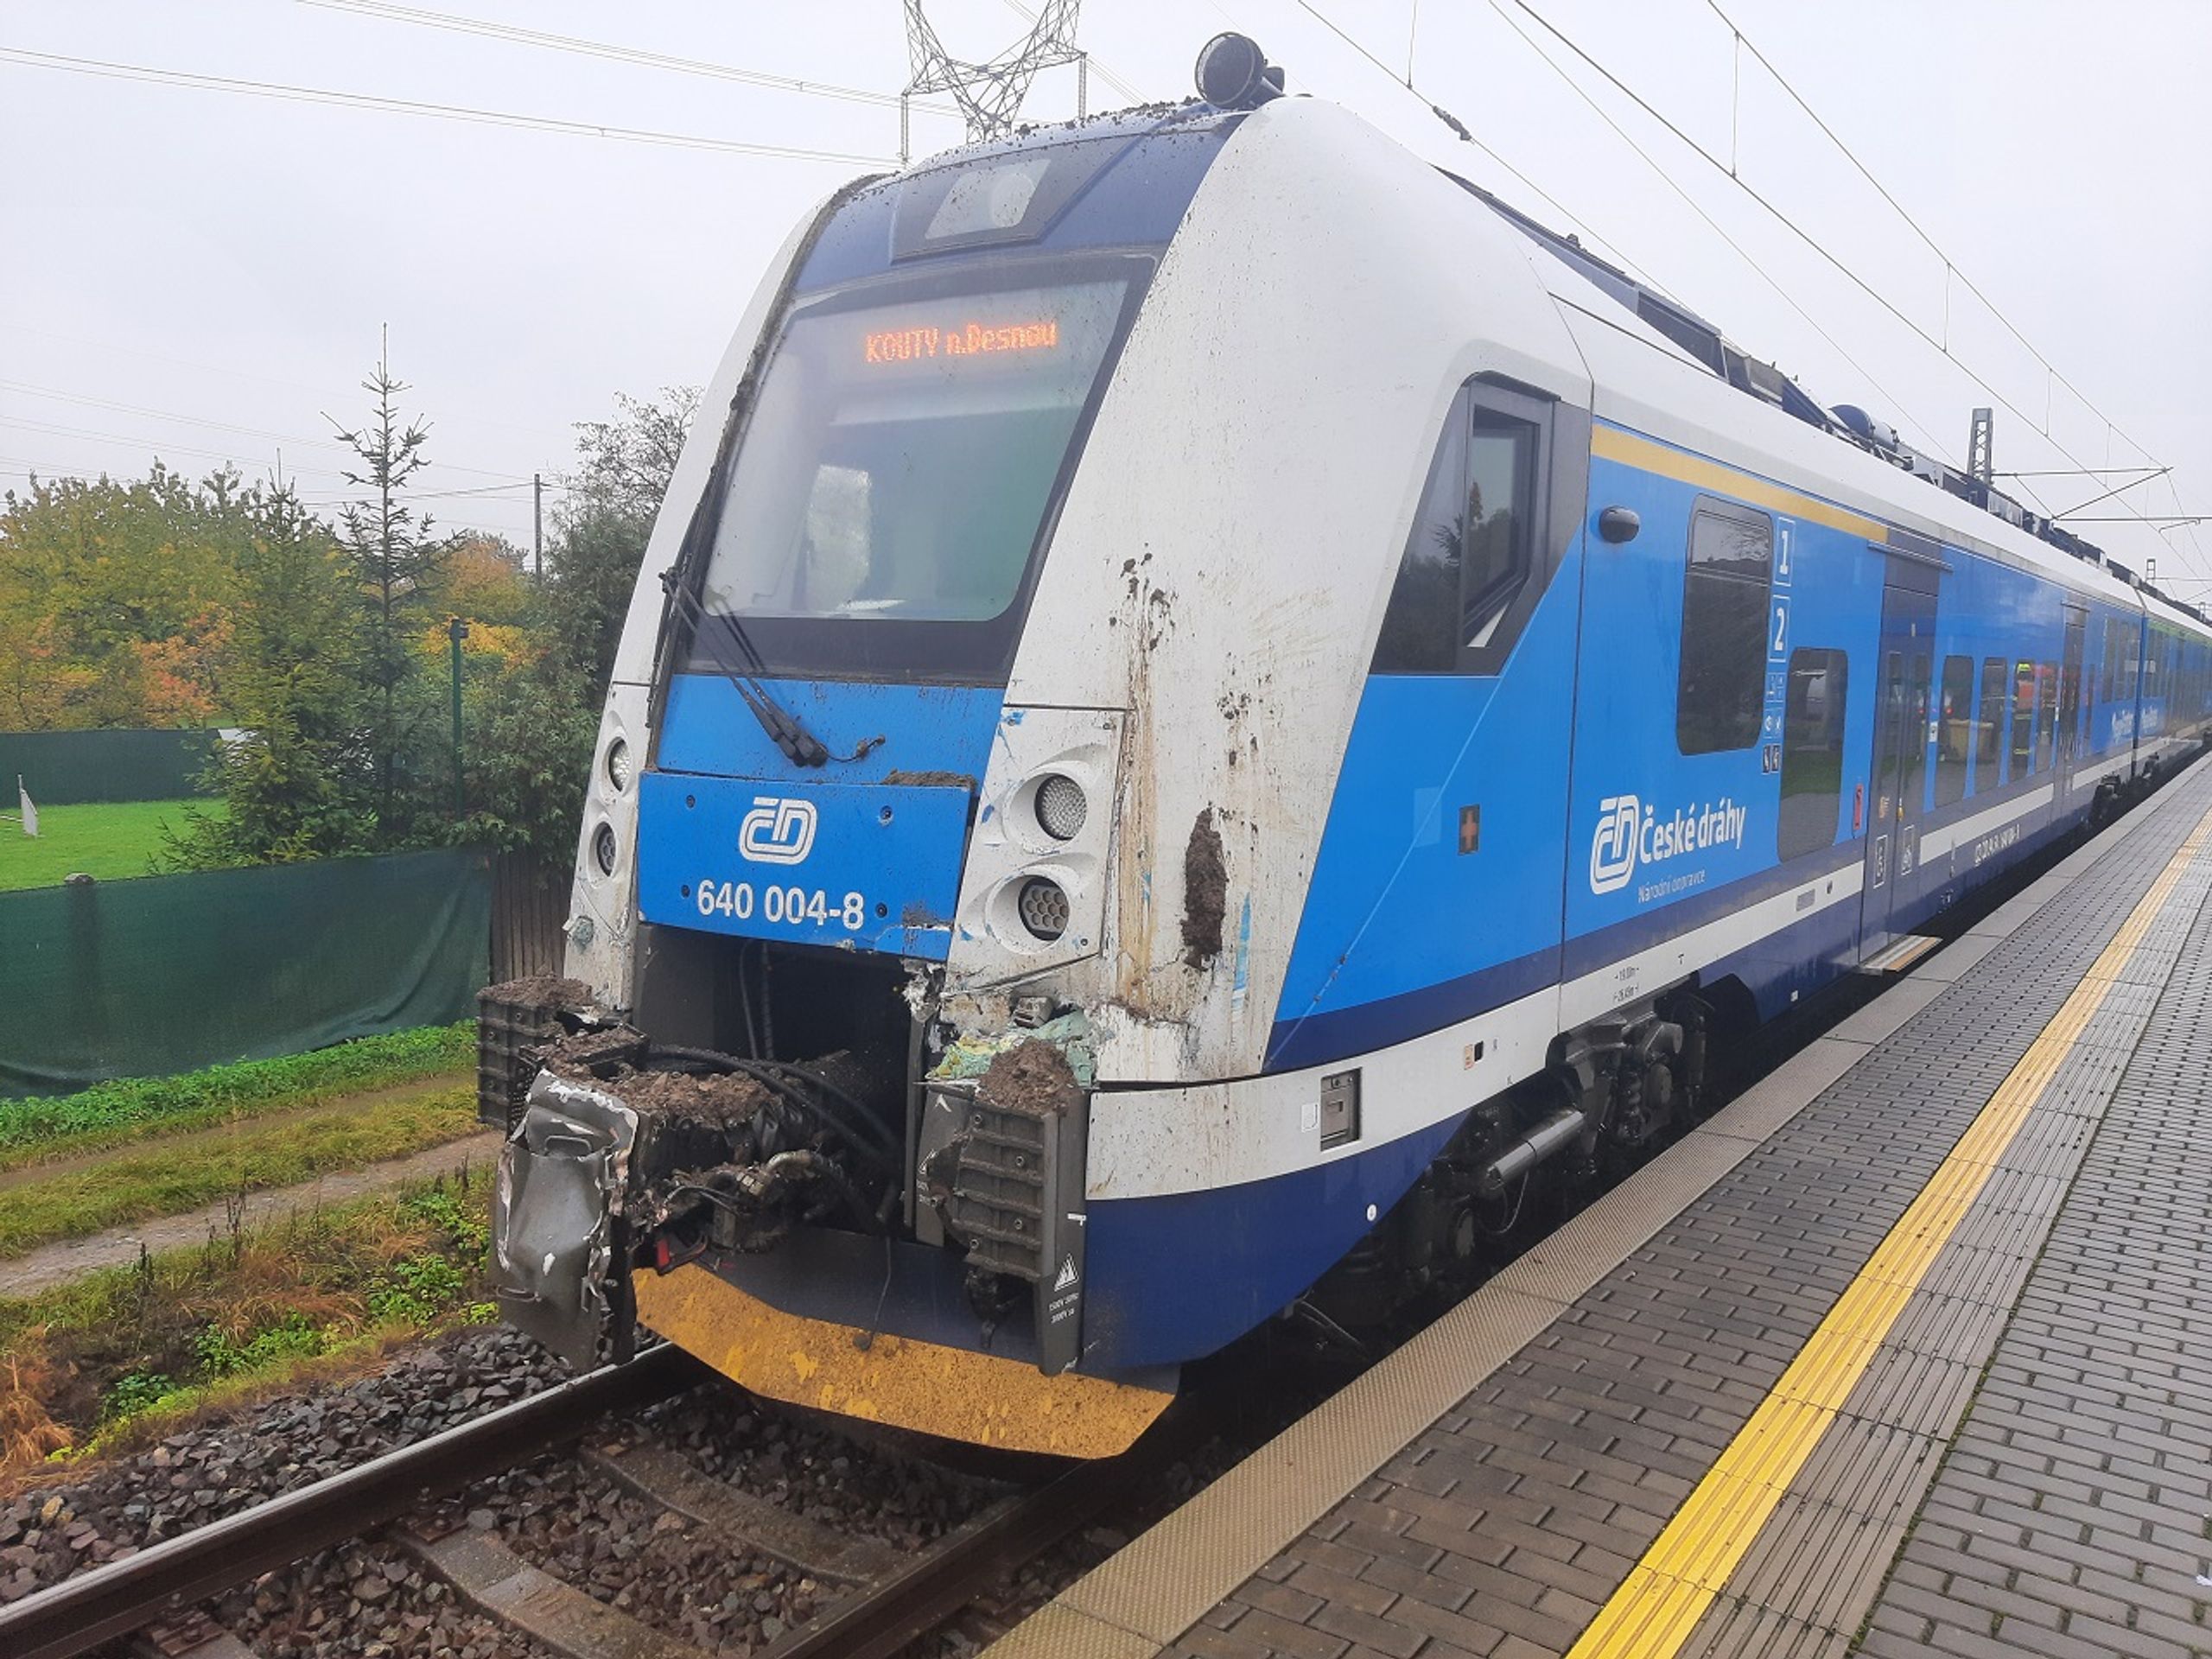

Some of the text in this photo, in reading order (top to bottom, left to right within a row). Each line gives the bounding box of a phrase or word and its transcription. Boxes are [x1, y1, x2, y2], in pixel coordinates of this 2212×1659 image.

[865, 327, 939, 363] KOUTY
[1780, 530, 1789, 575] 1
[1775, 607, 1785, 651] 2
[1640, 804, 1695, 864] České
[1697, 797, 1746, 850] dráhy
[697, 880, 864, 931] 640 004-8
